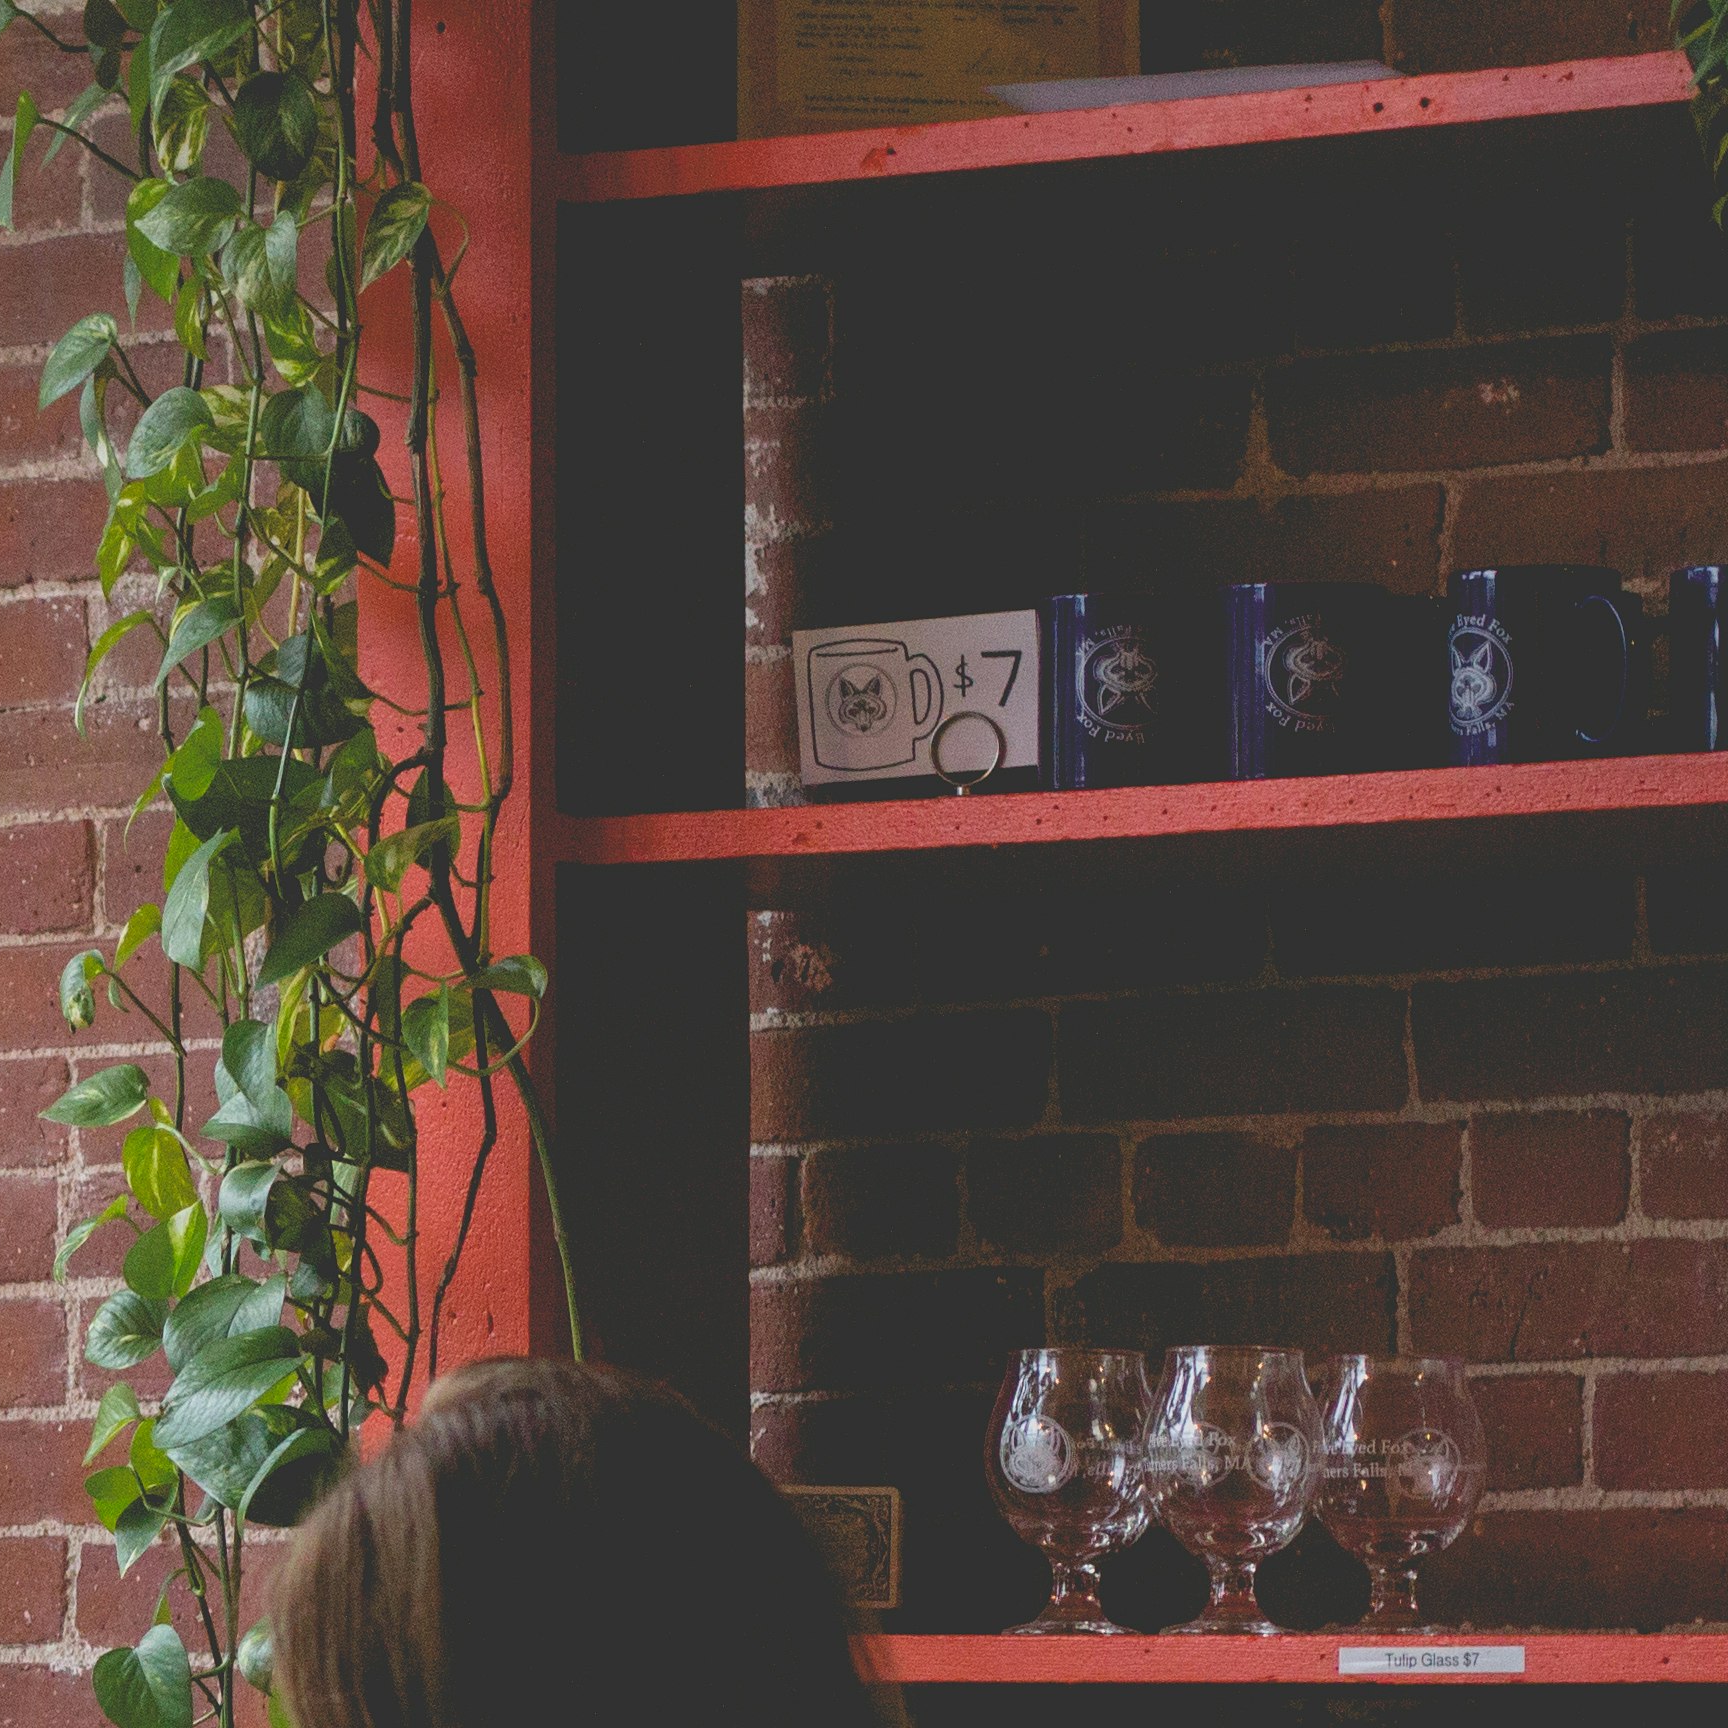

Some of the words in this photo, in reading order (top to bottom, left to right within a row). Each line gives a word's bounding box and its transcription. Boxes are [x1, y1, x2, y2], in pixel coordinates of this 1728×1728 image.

[1487, 617, 1513, 645] Fox
[1385, 1651, 1418, 1669] Tulip
[1420, 1651, 1460, 1668] Glass
[1462, 1651, 1481, 1668] $7
